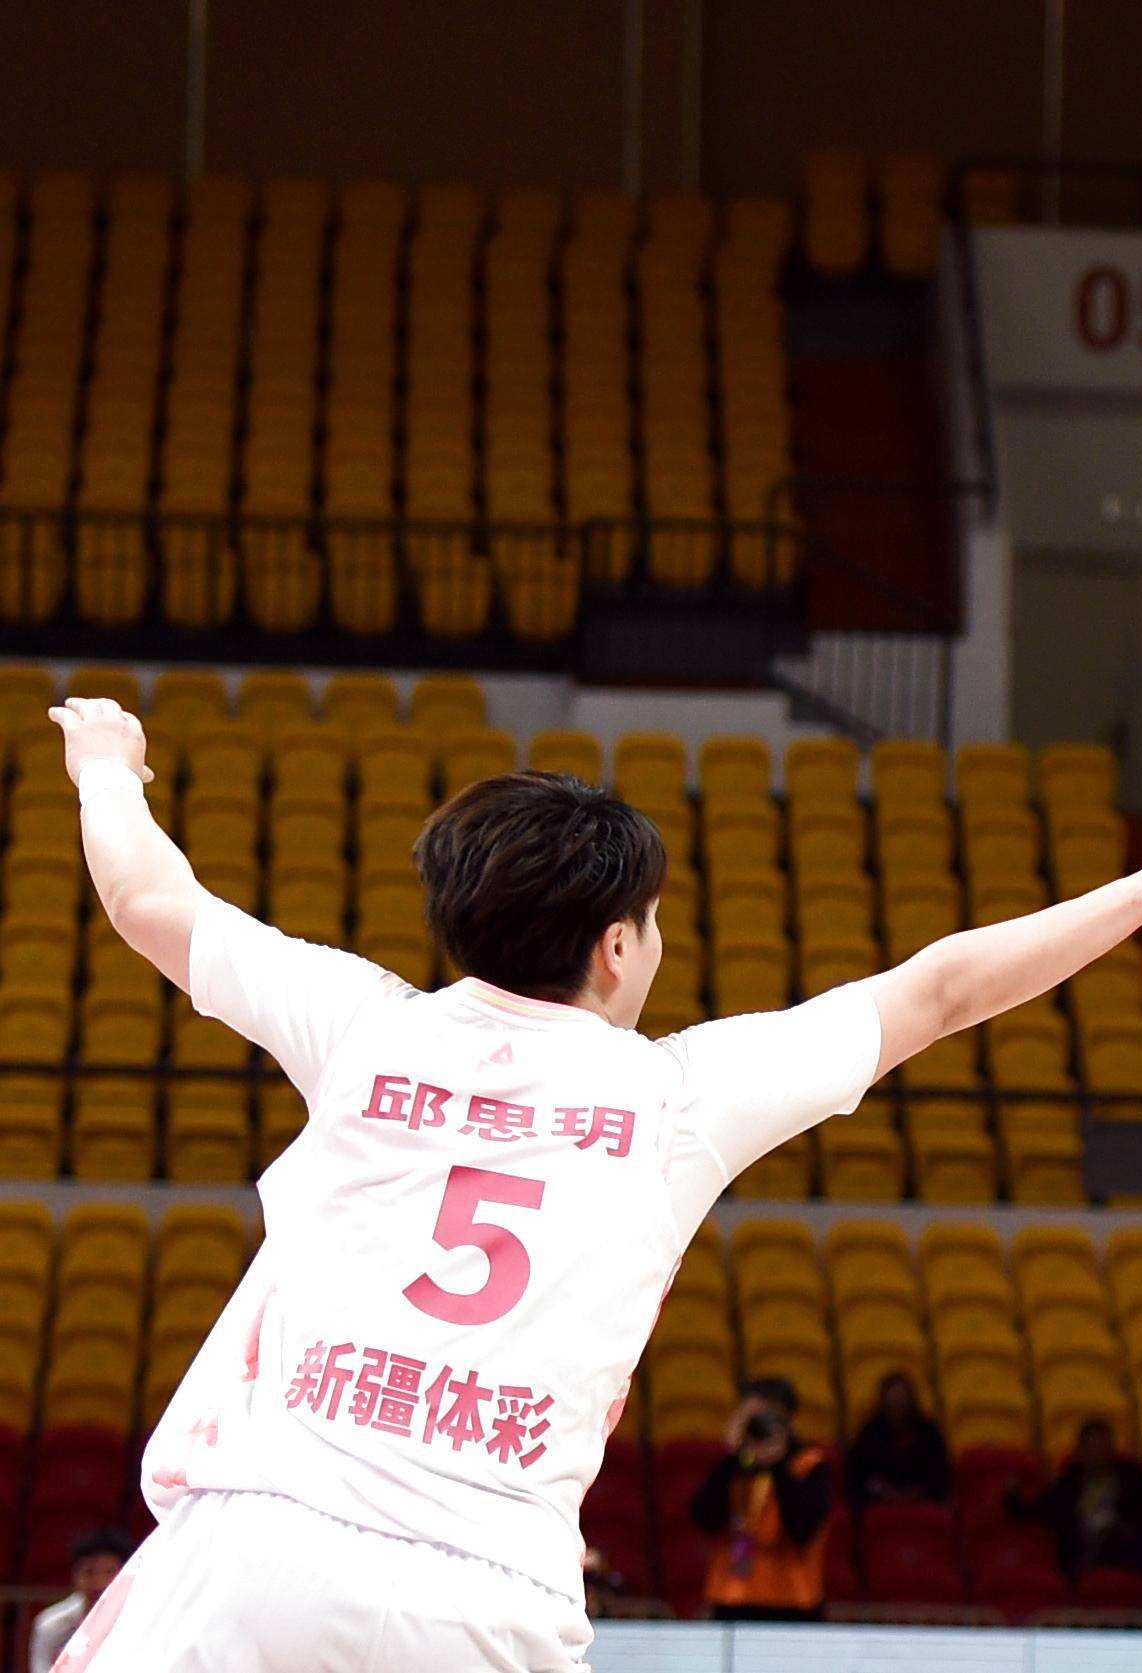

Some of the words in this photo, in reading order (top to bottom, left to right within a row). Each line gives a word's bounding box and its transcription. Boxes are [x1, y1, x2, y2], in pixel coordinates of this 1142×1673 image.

[361, 1073, 636, 1158] 邱思玥
[401, 1164, 546, 1326] 5
[284, 1340, 555, 1470] 新疆体彩
